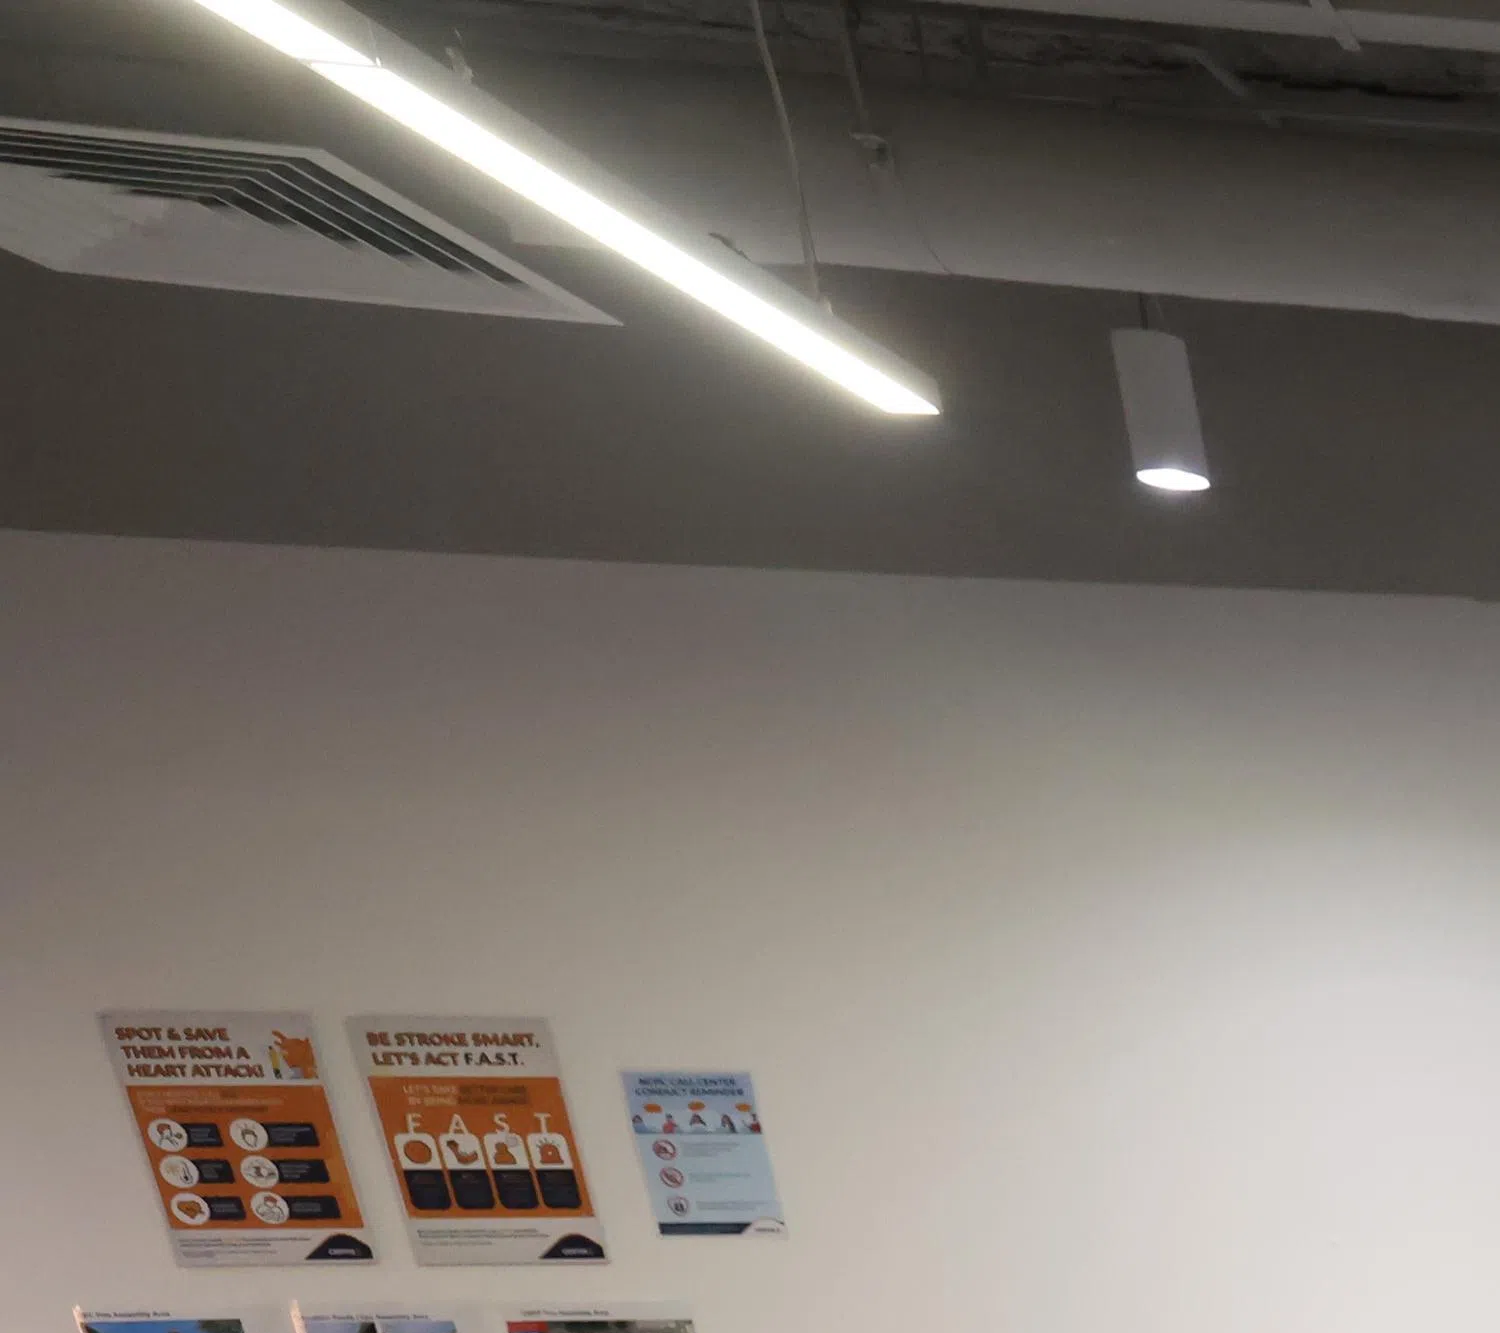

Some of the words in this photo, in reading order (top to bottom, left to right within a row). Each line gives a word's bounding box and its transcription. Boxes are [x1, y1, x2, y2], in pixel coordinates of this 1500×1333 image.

[115, 1027, 163, 1041] SPOT
[167, 1027, 182, 1041] &
[184, 1027, 230, 1042] SAVE
[366, 1032, 391, 1047] BE
[393, 1032, 469, 1048] STROKE
[120, 1046, 175, 1060] THEM
[179, 1045, 233, 1060] FROM
[237, 1046, 251, 1060] A
[372, 1052, 420, 1066] LET'S
[424, 1052, 460, 1066] ACT
[463, 1052, 525, 1066] F.A.S.T.
[127, 1064, 187, 1079] HEART
[191, 1063, 265, 1079] ATTACK!
[406, 1113, 422, 1133] F
[450, 1113, 469, 1133] A
[493, 1113, 509, 1132] S
[534, 1113, 551, 1133] T
